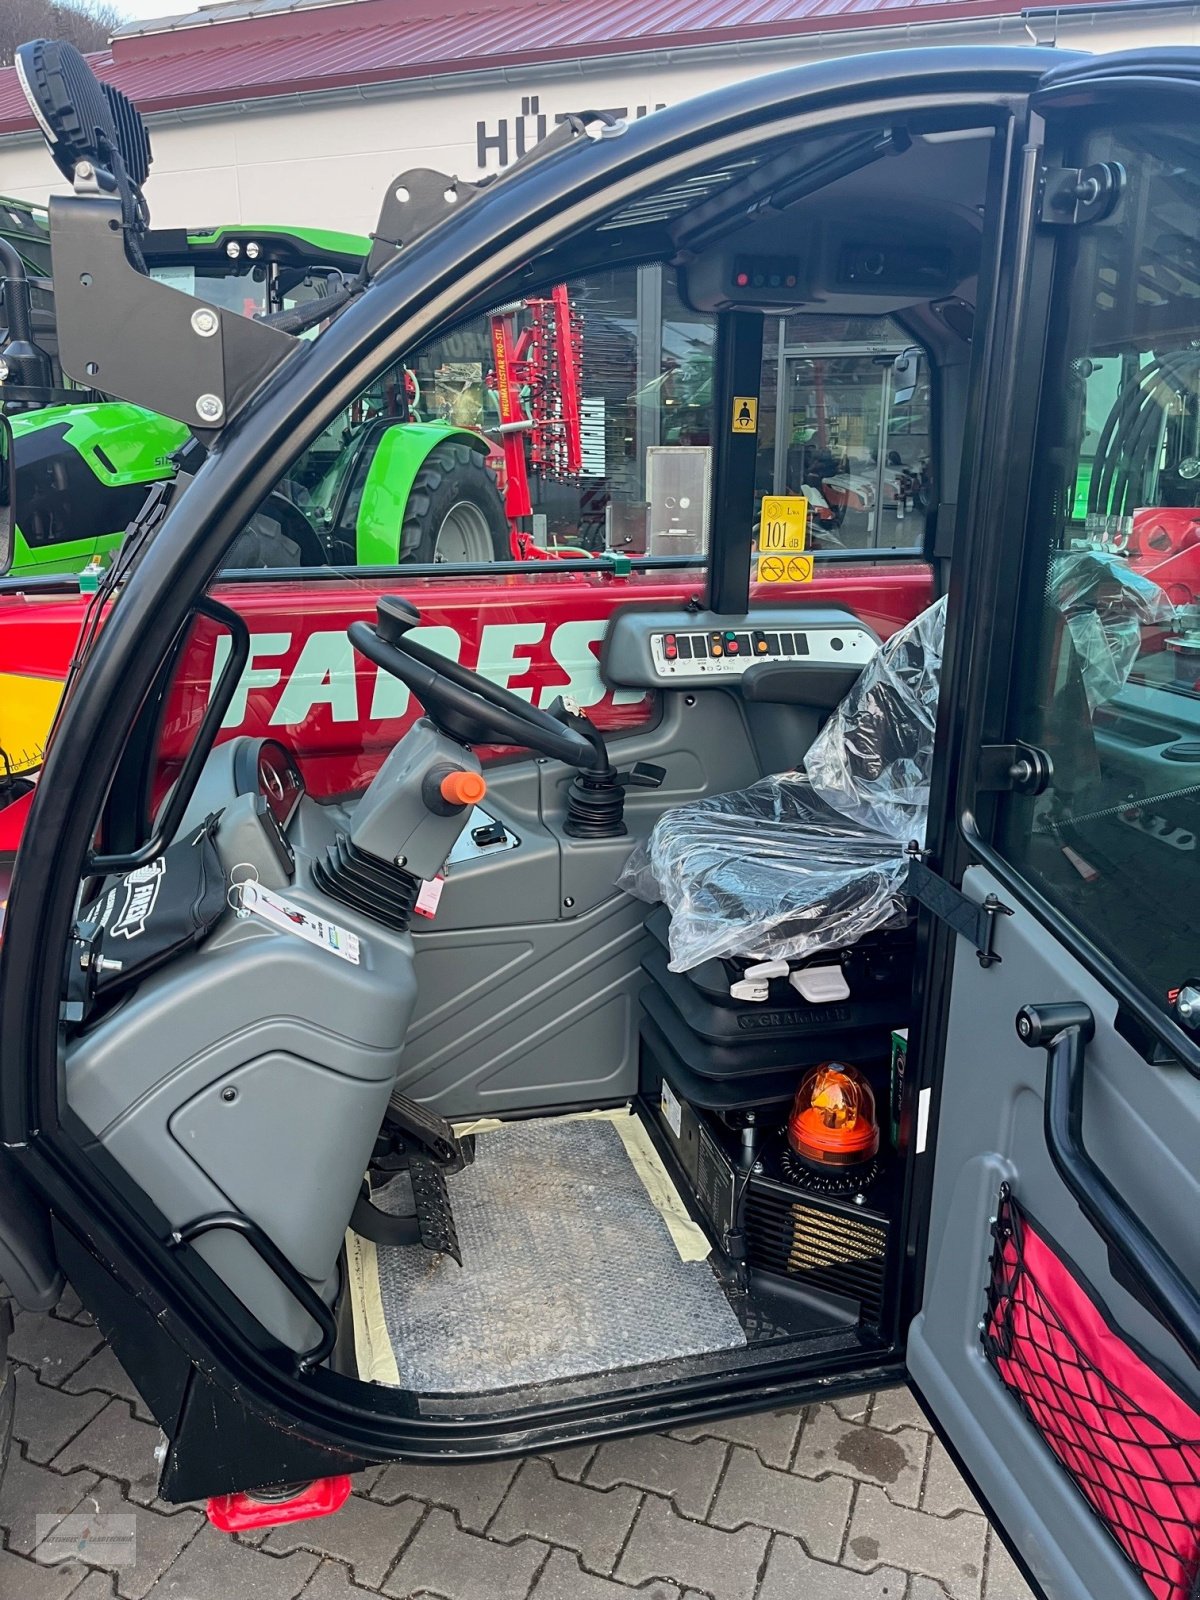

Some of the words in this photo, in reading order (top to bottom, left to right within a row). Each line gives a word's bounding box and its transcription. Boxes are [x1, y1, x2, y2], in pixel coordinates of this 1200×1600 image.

[496, 358, 511, 417] PNEUMATICSTAR
[765, 521, 787, 548] 101
[789, 538, 799, 548] dB
[208, 619, 647, 729] FARES
